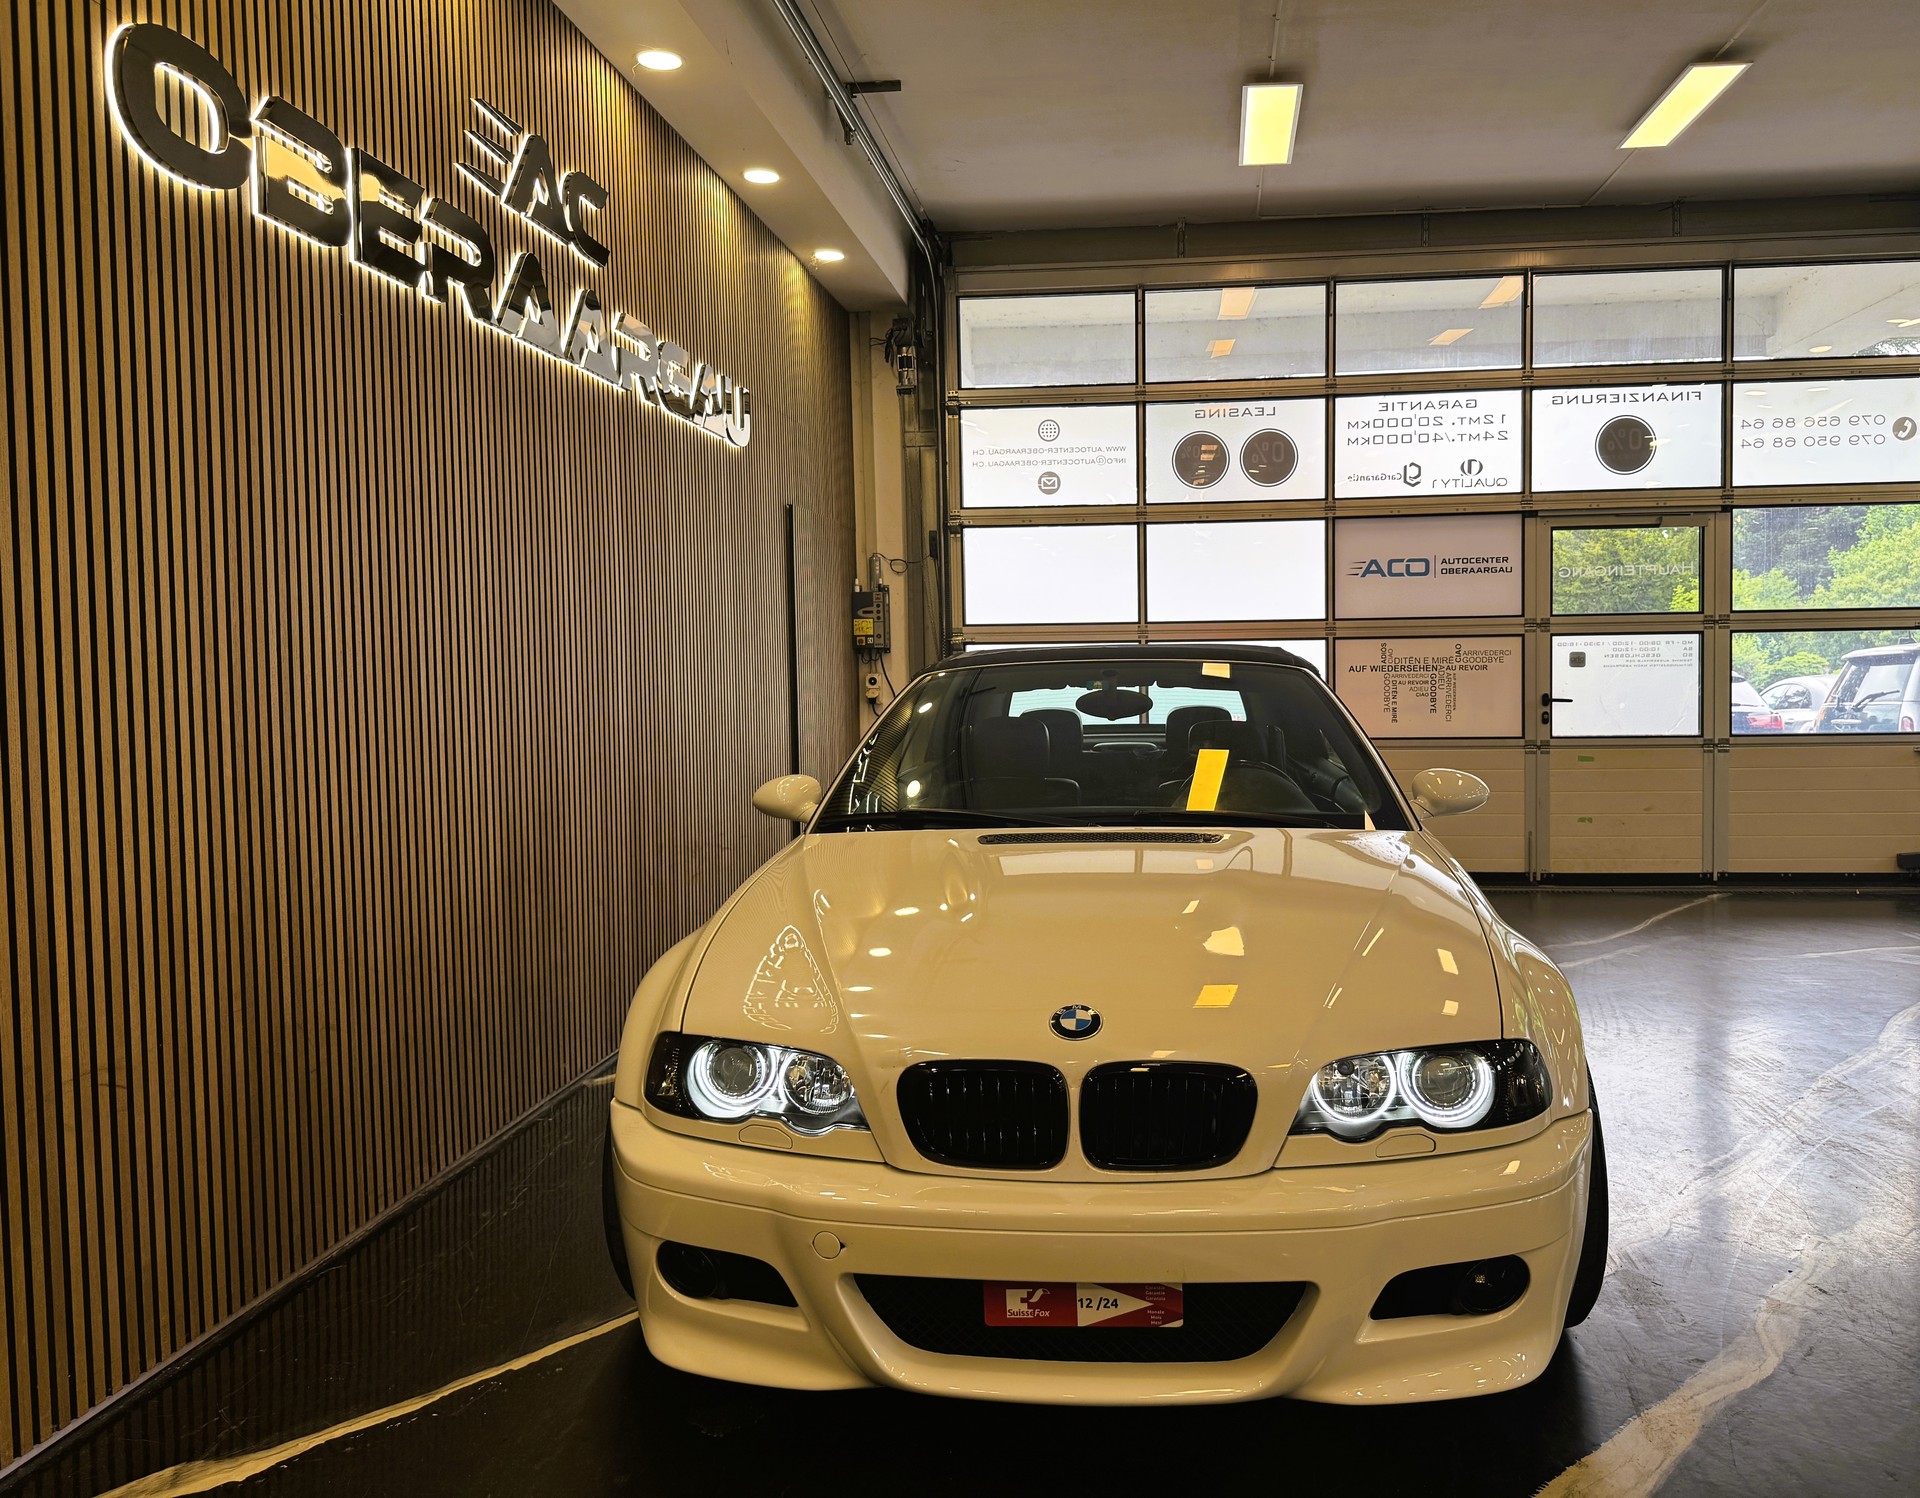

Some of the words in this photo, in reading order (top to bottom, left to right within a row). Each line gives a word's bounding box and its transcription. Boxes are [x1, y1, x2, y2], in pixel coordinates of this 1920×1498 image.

[1440, 556, 1509, 565] AUTOCENTER
[1360, 557, 1430, 577] ACO
[1440, 566, 1513, 575] OBERAARGAU
[1348, 665, 1367, 673] AUF
[1370, 665, 1438, 673] WIEDERSEHEN
[1078, 1297, 1093, 1309] 12
